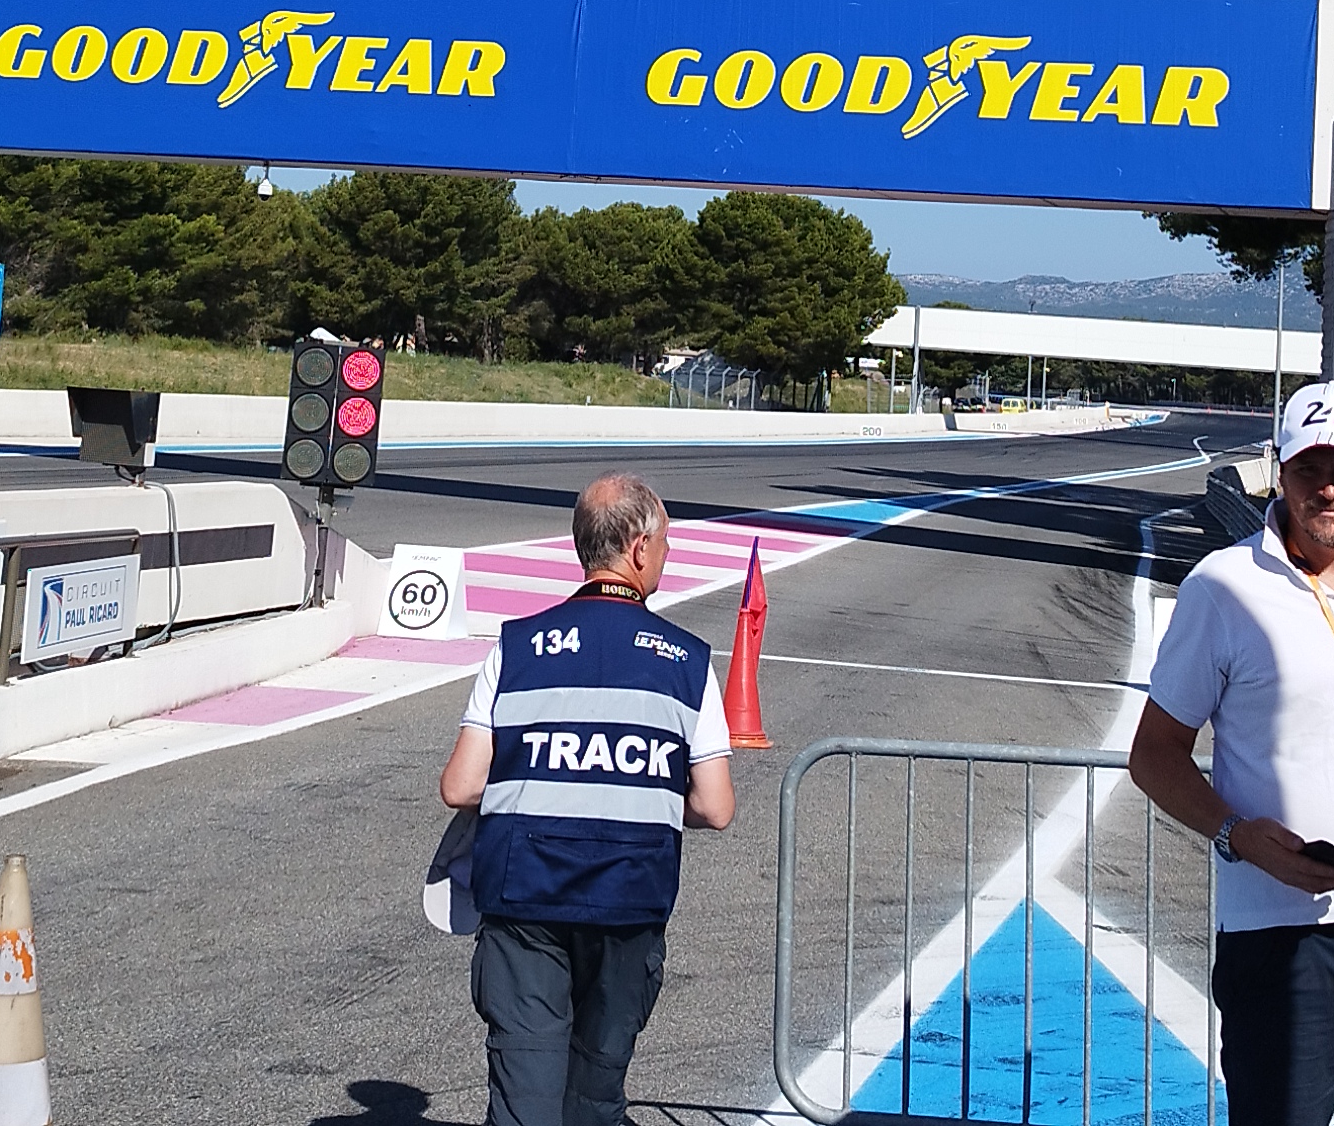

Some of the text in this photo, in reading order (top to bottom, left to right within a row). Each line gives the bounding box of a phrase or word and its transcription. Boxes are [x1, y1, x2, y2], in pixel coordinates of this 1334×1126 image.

[862, 426, 882, 437] 200
[66, 578, 121, 603] CIRCUIT
[401, 582, 438, 606] 60
[601, 582, 641, 601] Canon
[64, 601, 119, 629] PAUL RICARD
[400, 605, 431, 618] km/h
[530, 626, 581, 656] 134
[522, 730, 680, 779] TRACK
